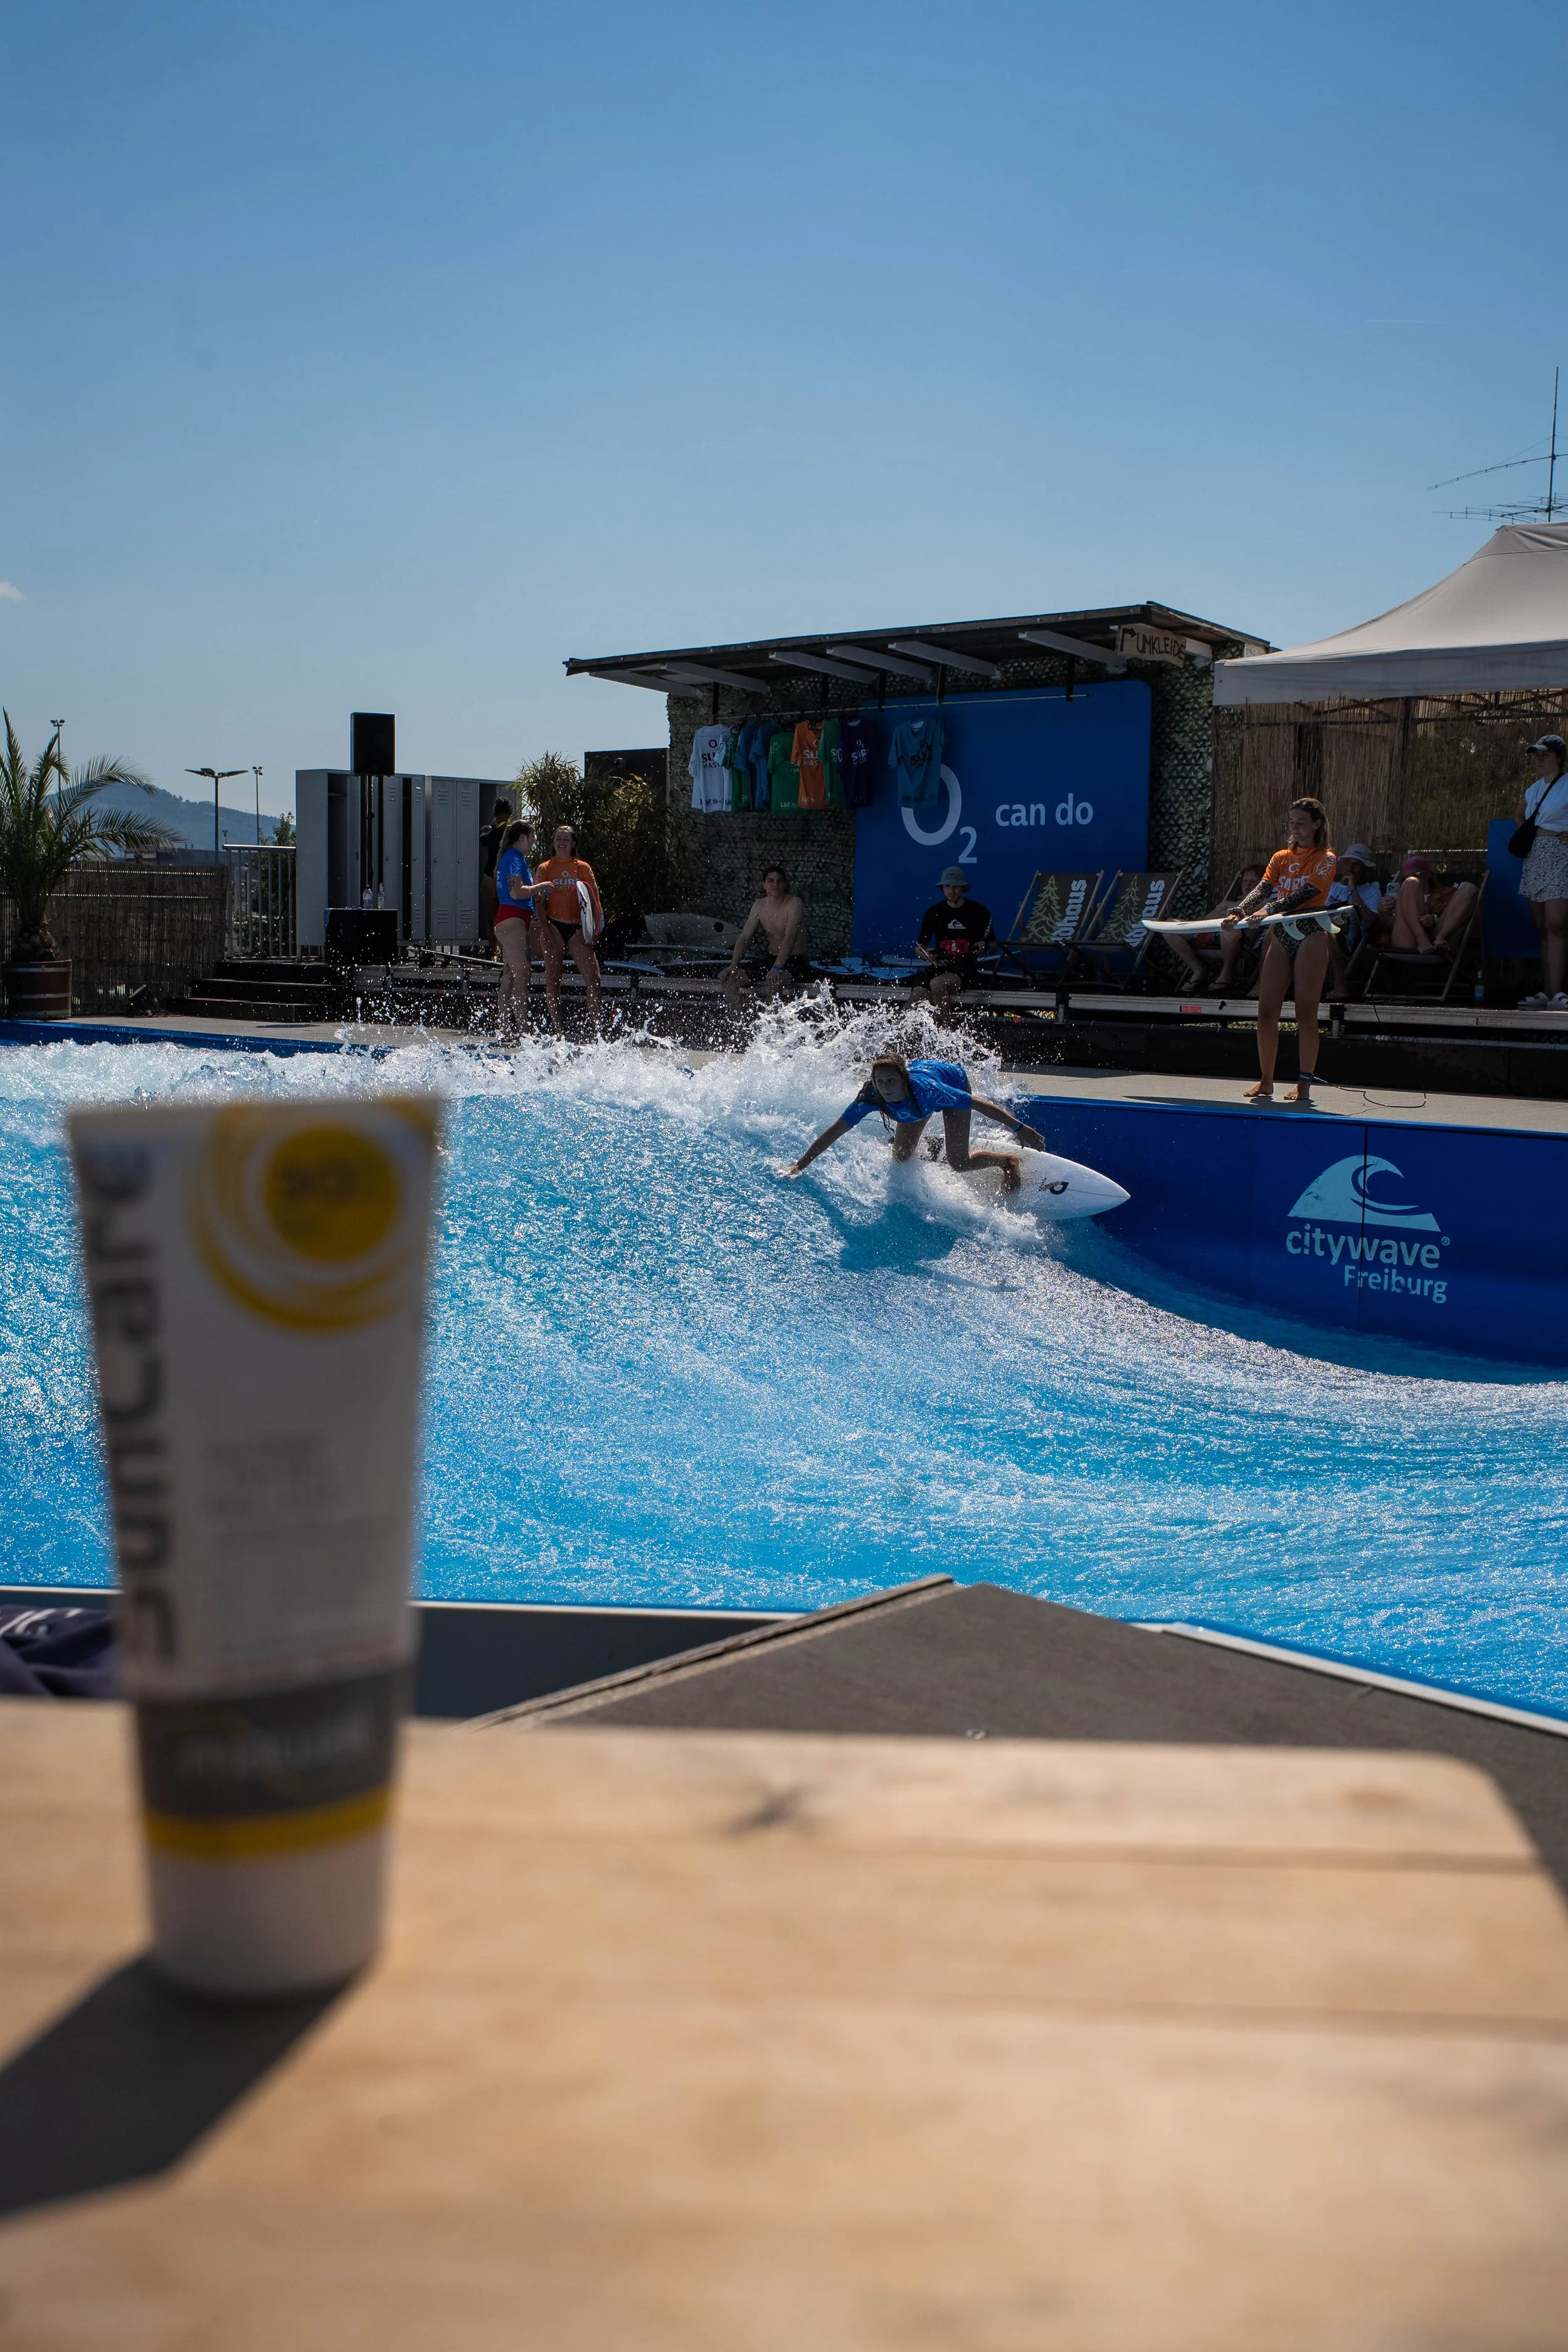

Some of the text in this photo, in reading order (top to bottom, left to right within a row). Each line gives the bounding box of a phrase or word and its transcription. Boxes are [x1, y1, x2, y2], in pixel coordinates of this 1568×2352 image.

[995, 803, 1046, 827] can
[1055, 793, 1094, 825] do
[1050, 879, 1088, 946] ldhaus
[1343, 1264, 1448, 1304] Freiburg
